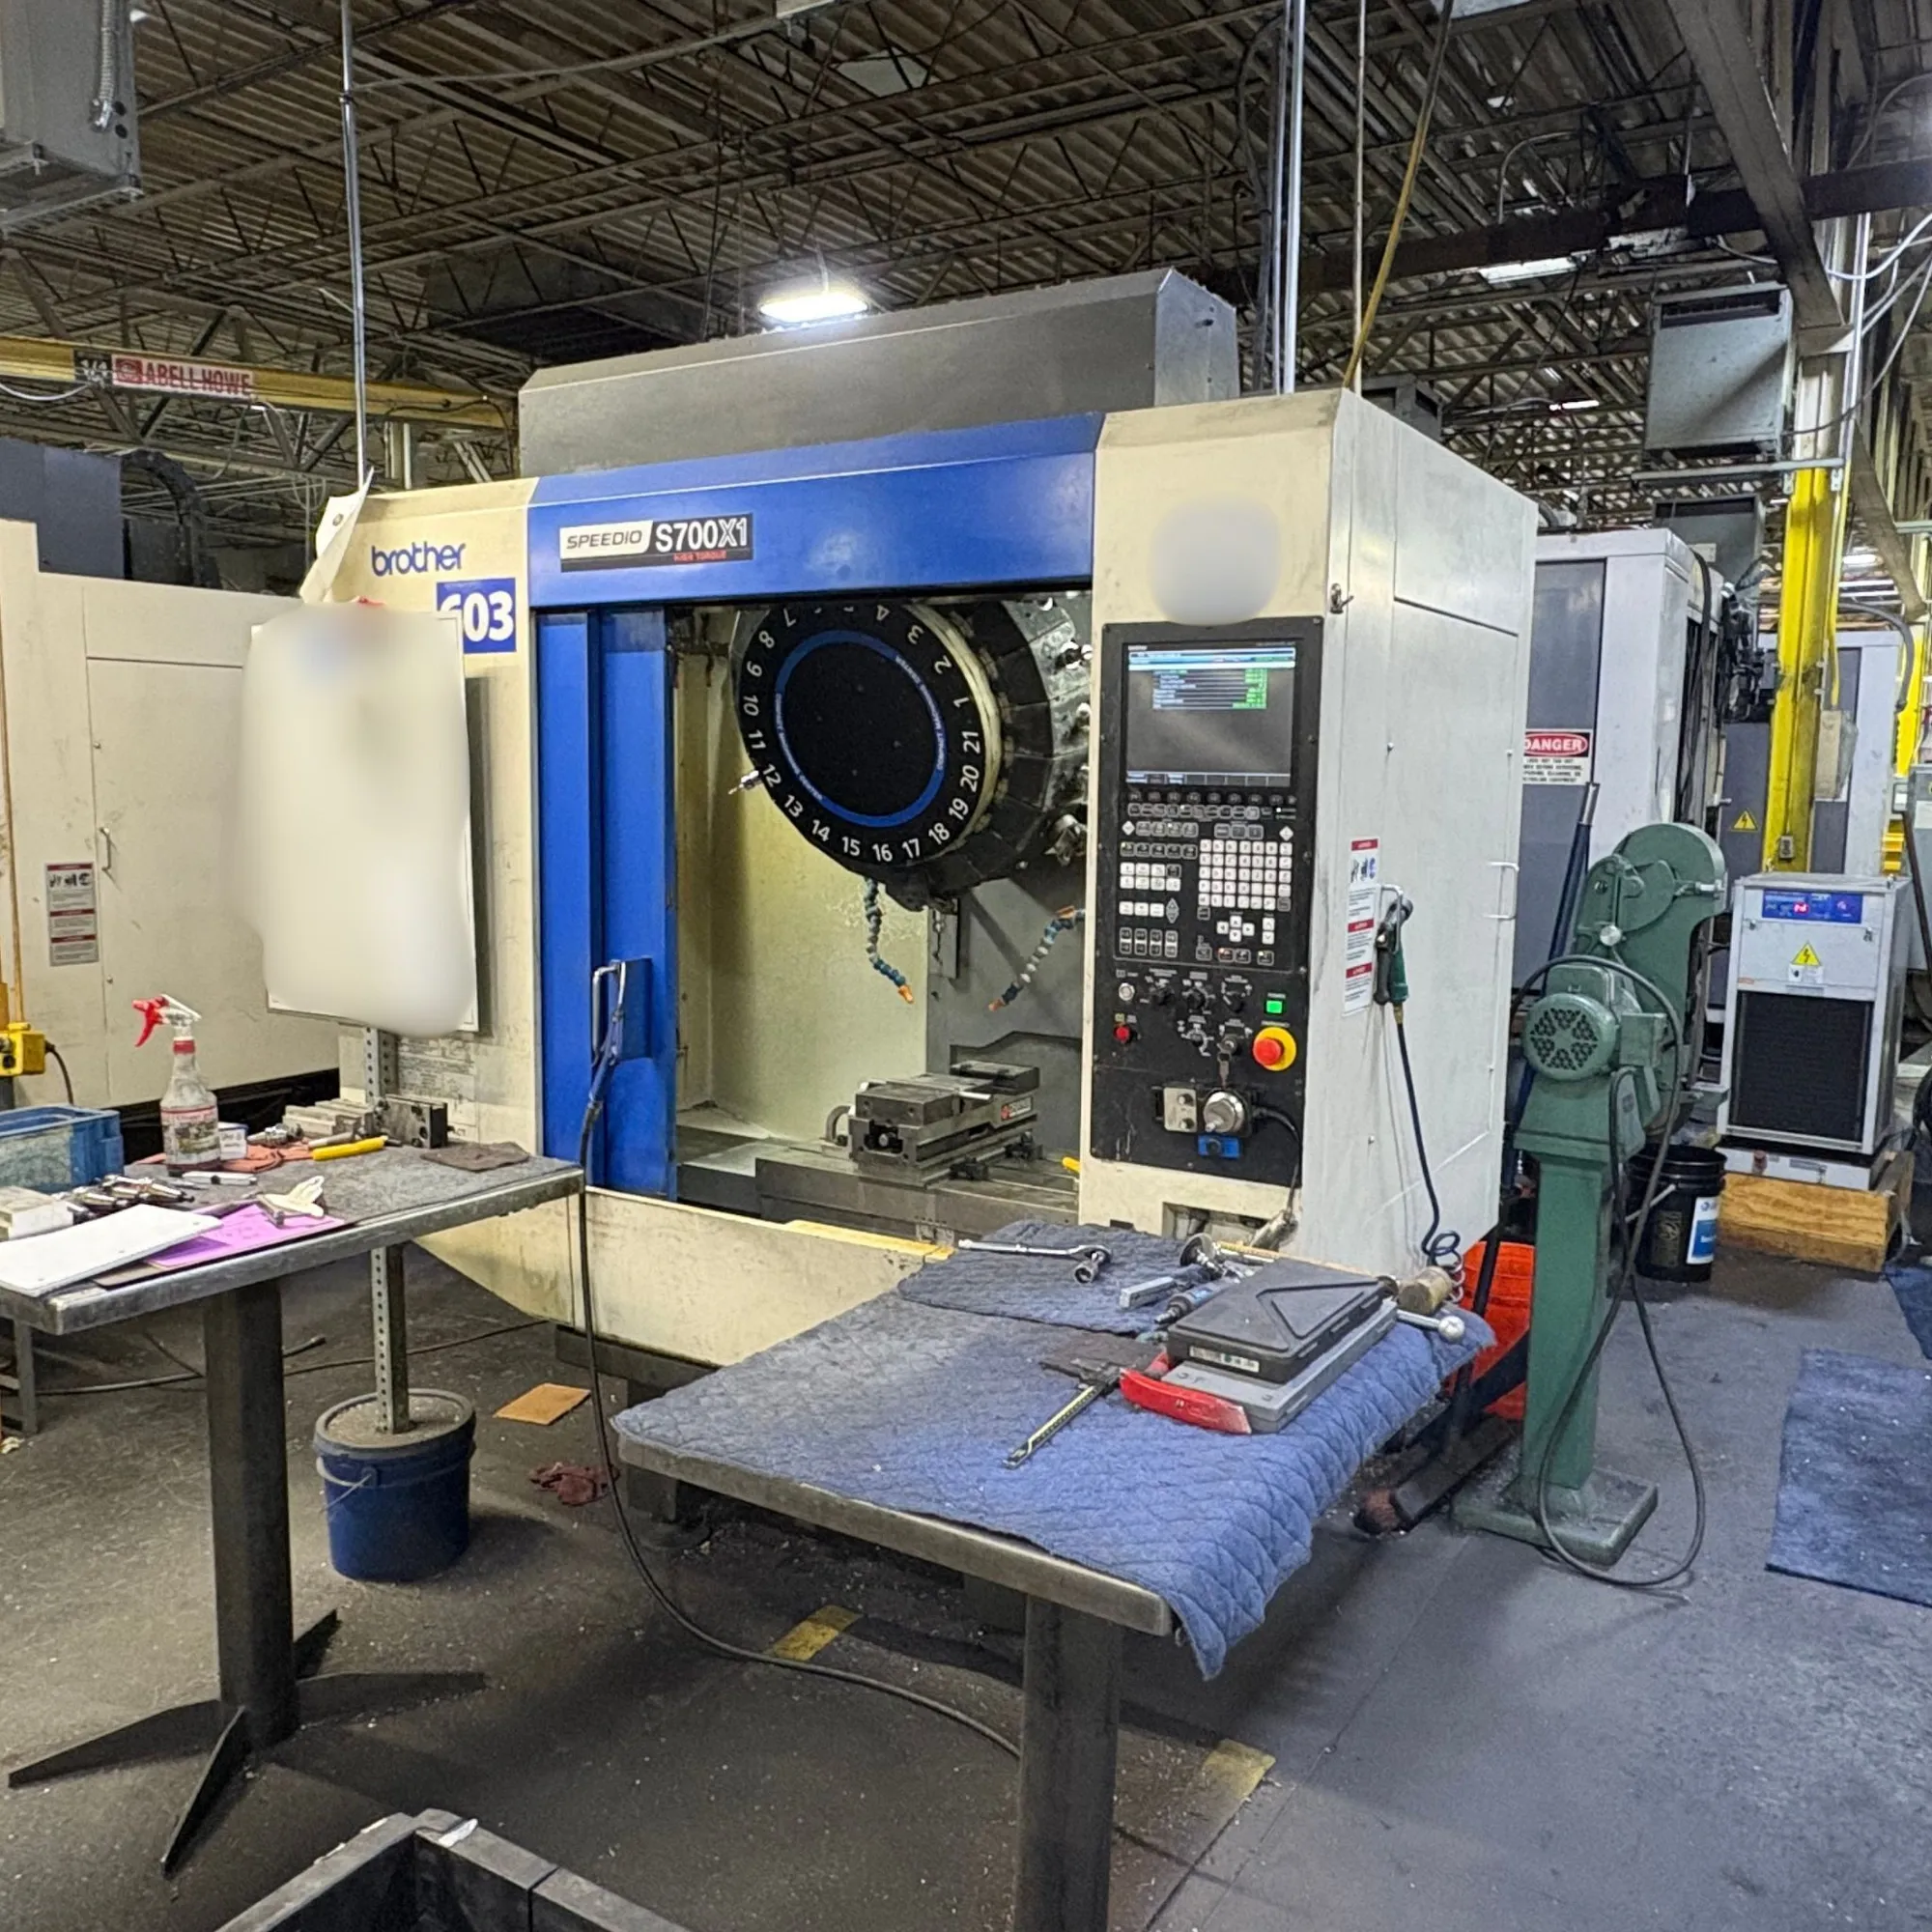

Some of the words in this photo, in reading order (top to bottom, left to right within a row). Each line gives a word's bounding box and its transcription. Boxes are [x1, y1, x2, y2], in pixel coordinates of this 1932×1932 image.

[567, 530, 642, 549] SPEEDIO
[656, 518, 748, 553] S700X1
[371, 541, 466, 577] brother
[876, 605, 890, 621] 4
[758, 631, 775, 649] 8
[907, 625, 923, 644] 3
[747, 661, 762, 677] 9
[934, 655, 952, 674] 2
[743, 696, 759, 716] 10
[952, 696, 969, 708] 1
[748, 730, 766, 750] 11
[961, 730, 980, 753] 21
[1524, 738, 1582, 752] DANGER
[762, 764, 781, 787] 12
[960, 765, 980, 792] 20
[784, 794, 804, 817] 13
[949, 798, 969, 820] 19
[811, 820, 830, 841] 14
[928, 822, 950, 845] 18
[841, 836, 861, 856] 15
[872, 843, 893, 862] 16
[901, 838, 920, 858] 17
